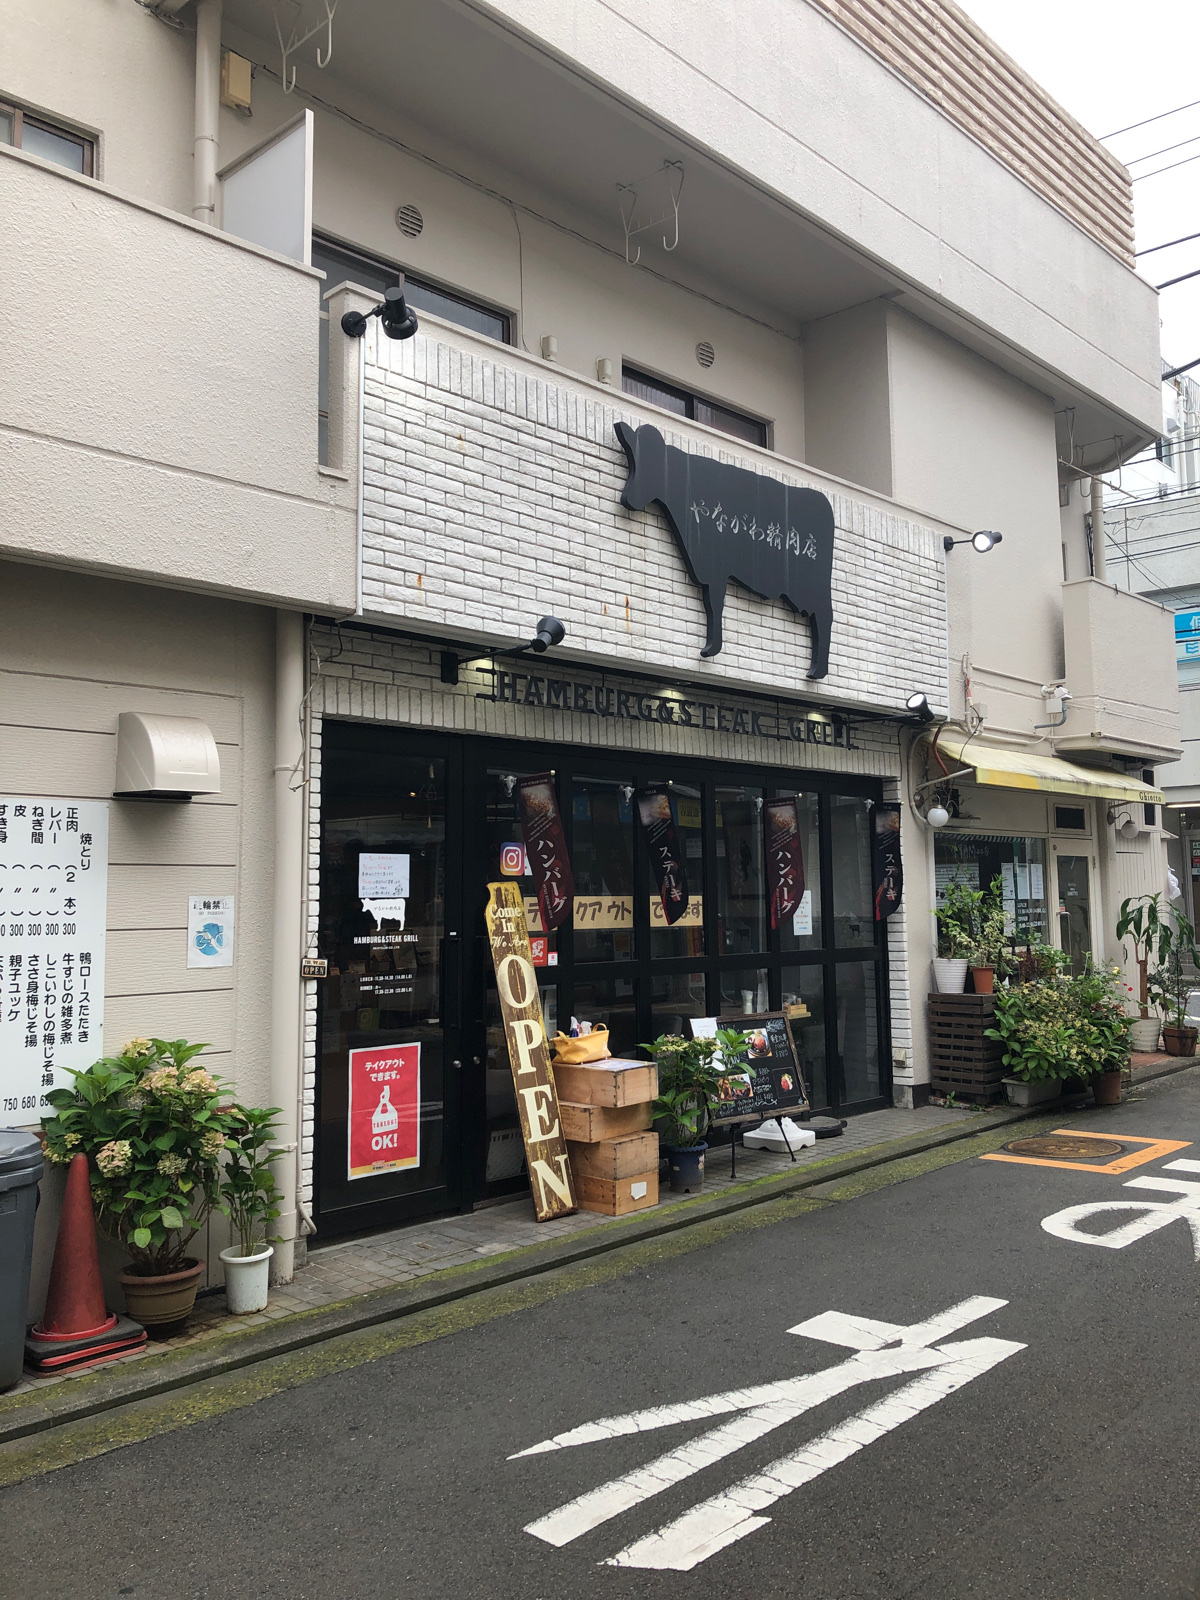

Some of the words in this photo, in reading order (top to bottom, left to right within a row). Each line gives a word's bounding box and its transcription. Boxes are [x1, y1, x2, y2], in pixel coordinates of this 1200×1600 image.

[689, 499, 818, 560] やながわ精肉店
[496, 671, 763, 737] HAMBURG&STEAK
[1139, 791, 1162, 803] Ghiotto
[13, 804, 27, 818] 皮
[66, 807, 78, 832] 正肉
[31, 805, 45, 844] ねぎ間
[49, 806, 62, 844] レバー
[80, 833, 92, 871] 焼とり
[537, 839, 568, 913] ハンバーグ
[659, 846, 682, 901] ステーキ
[776, 851, 795, 914] ハンバーグ
[885, 853, 898, 901] ステーキ
[489, 904, 522, 919] Come
[9, 923, 24, 937] 300
[27, 923, 42, 937] 300
[45, 923, 59, 936] 300
[62, 922, 76, 936] 300
[501, 919, 516, 933] In
[353, 935, 402, 944] HAMBURG&STEAK
[403, 934, 419, 943] GRILL
[491, 936, 506, 949] We
[508, 935, 528, 947] Are
[304, 966, 325, 975] OPEN
[8, 954, 23, 1022] 親子ユッケ
[78, 951, 92, 1043] 鴨ロースたたき
[24, 953, 40, 1048] ささ身梅じそ揚
[60, 952, 75, 1045] 牛すじの雑多煮
[41, 953, 57, 1087] しこいわしの梅じそ揚
[365, 1058, 405, 1071] テイクアウト
[370, 1070, 401, 1082] できます。
[497, 954, 572, 1216] OPEN
[3, 1098, 18, 1112] 750
[21, 1095, 36, 1110] 680
[373, 1118, 397, 1129] TAKEOUT
[371, 1133, 398, 1151] OK!
